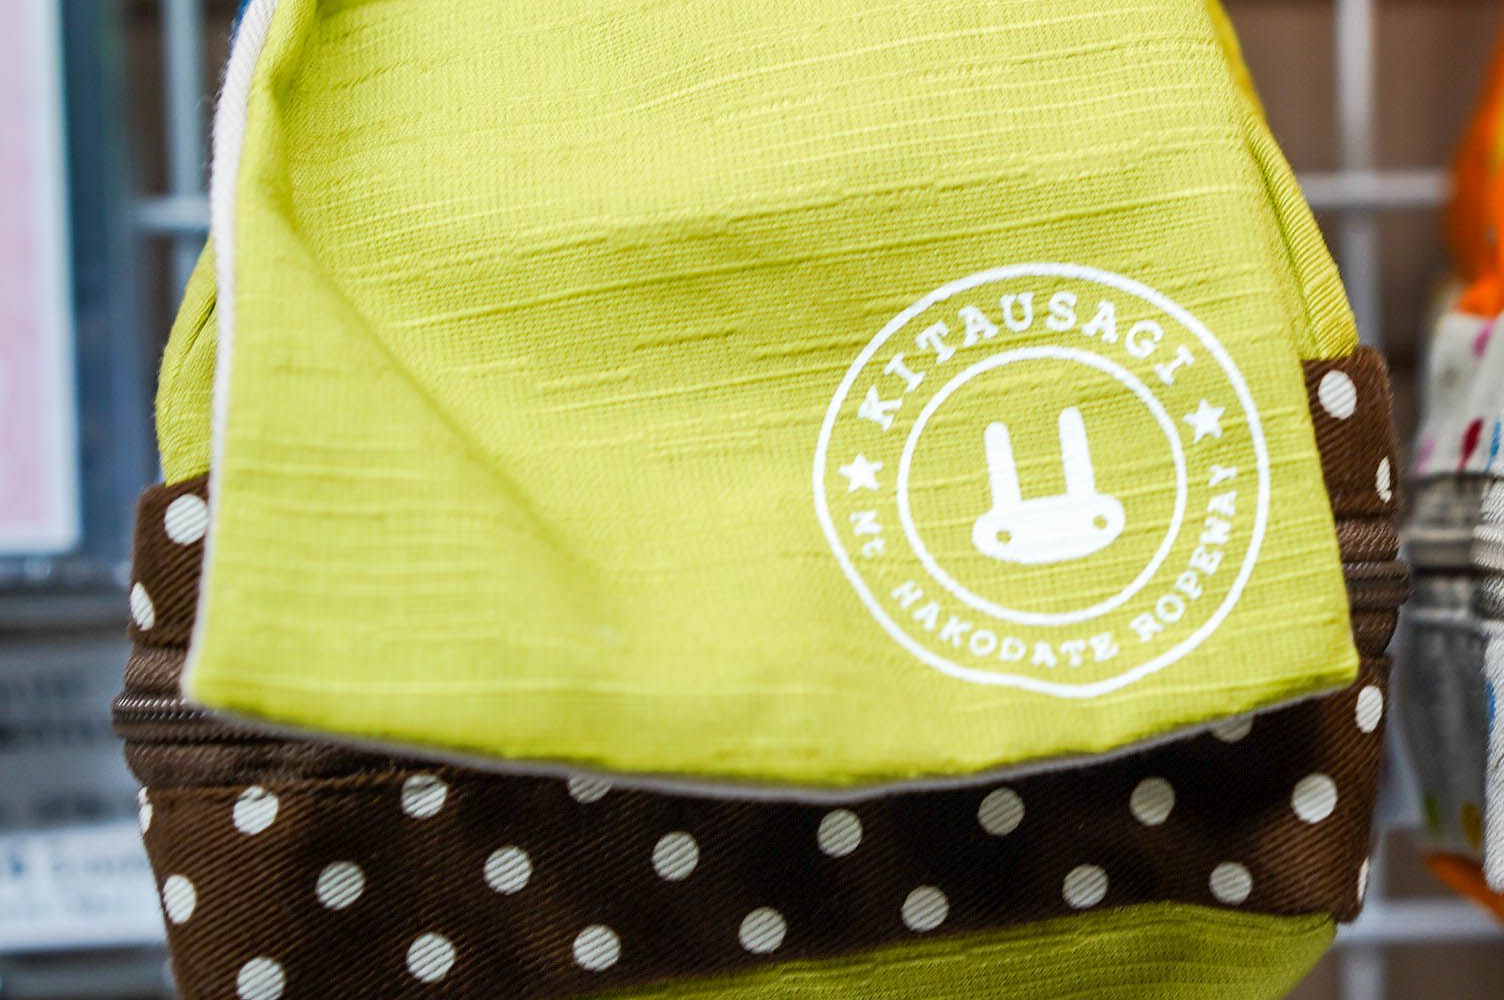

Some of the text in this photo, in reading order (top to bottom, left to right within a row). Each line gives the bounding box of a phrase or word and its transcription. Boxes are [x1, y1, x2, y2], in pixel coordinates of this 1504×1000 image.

[857, 292, 1194, 431] KITAUSAGI
[892, 581, 1118, 668] HAKODATE
[1130, 464, 1237, 641] ROPEWAY
